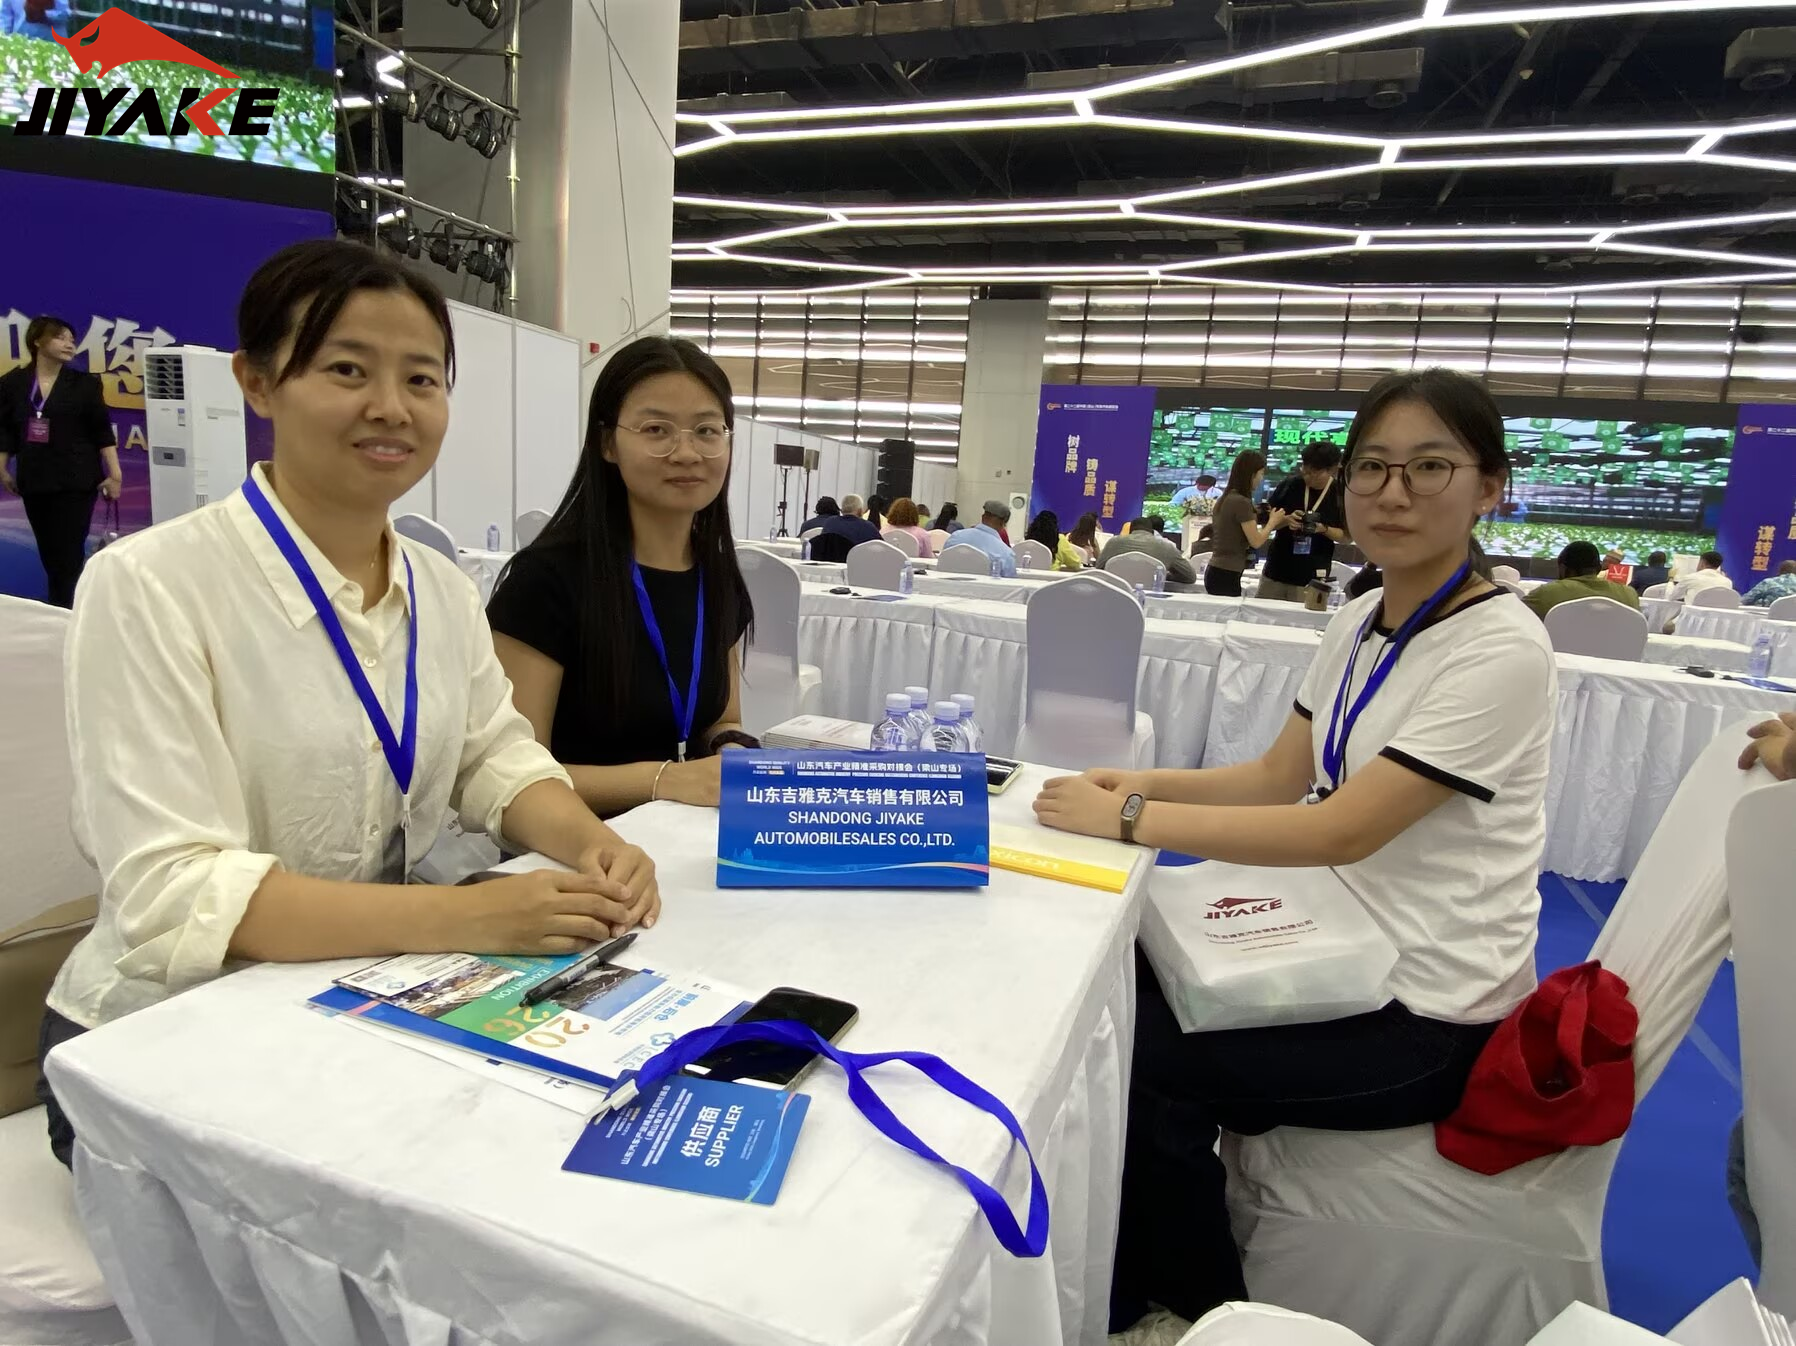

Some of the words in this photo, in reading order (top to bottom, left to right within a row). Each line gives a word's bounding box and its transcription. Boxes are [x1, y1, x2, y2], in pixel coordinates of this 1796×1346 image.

[1065, 434, 1080, 473] 树品牌
[747, 786, 964, 807] 山东吉雅克汽车销售有限公司
[788, 811, 872, 825] SHANDONG
[875, 812, 925, 825] JIYAKE
[754, 831, 896, 846] AUTOMOBILESALES
[899, 832, 955, 848] CO.,LTD.
[1203, 898, 1283, 919] JIYAKE
[491, 966, 551, 1000] EXHIBITION
[680, 1105, 722, 1157] 供应商
[705, 1104, 744, 1168] SUPPLIER
